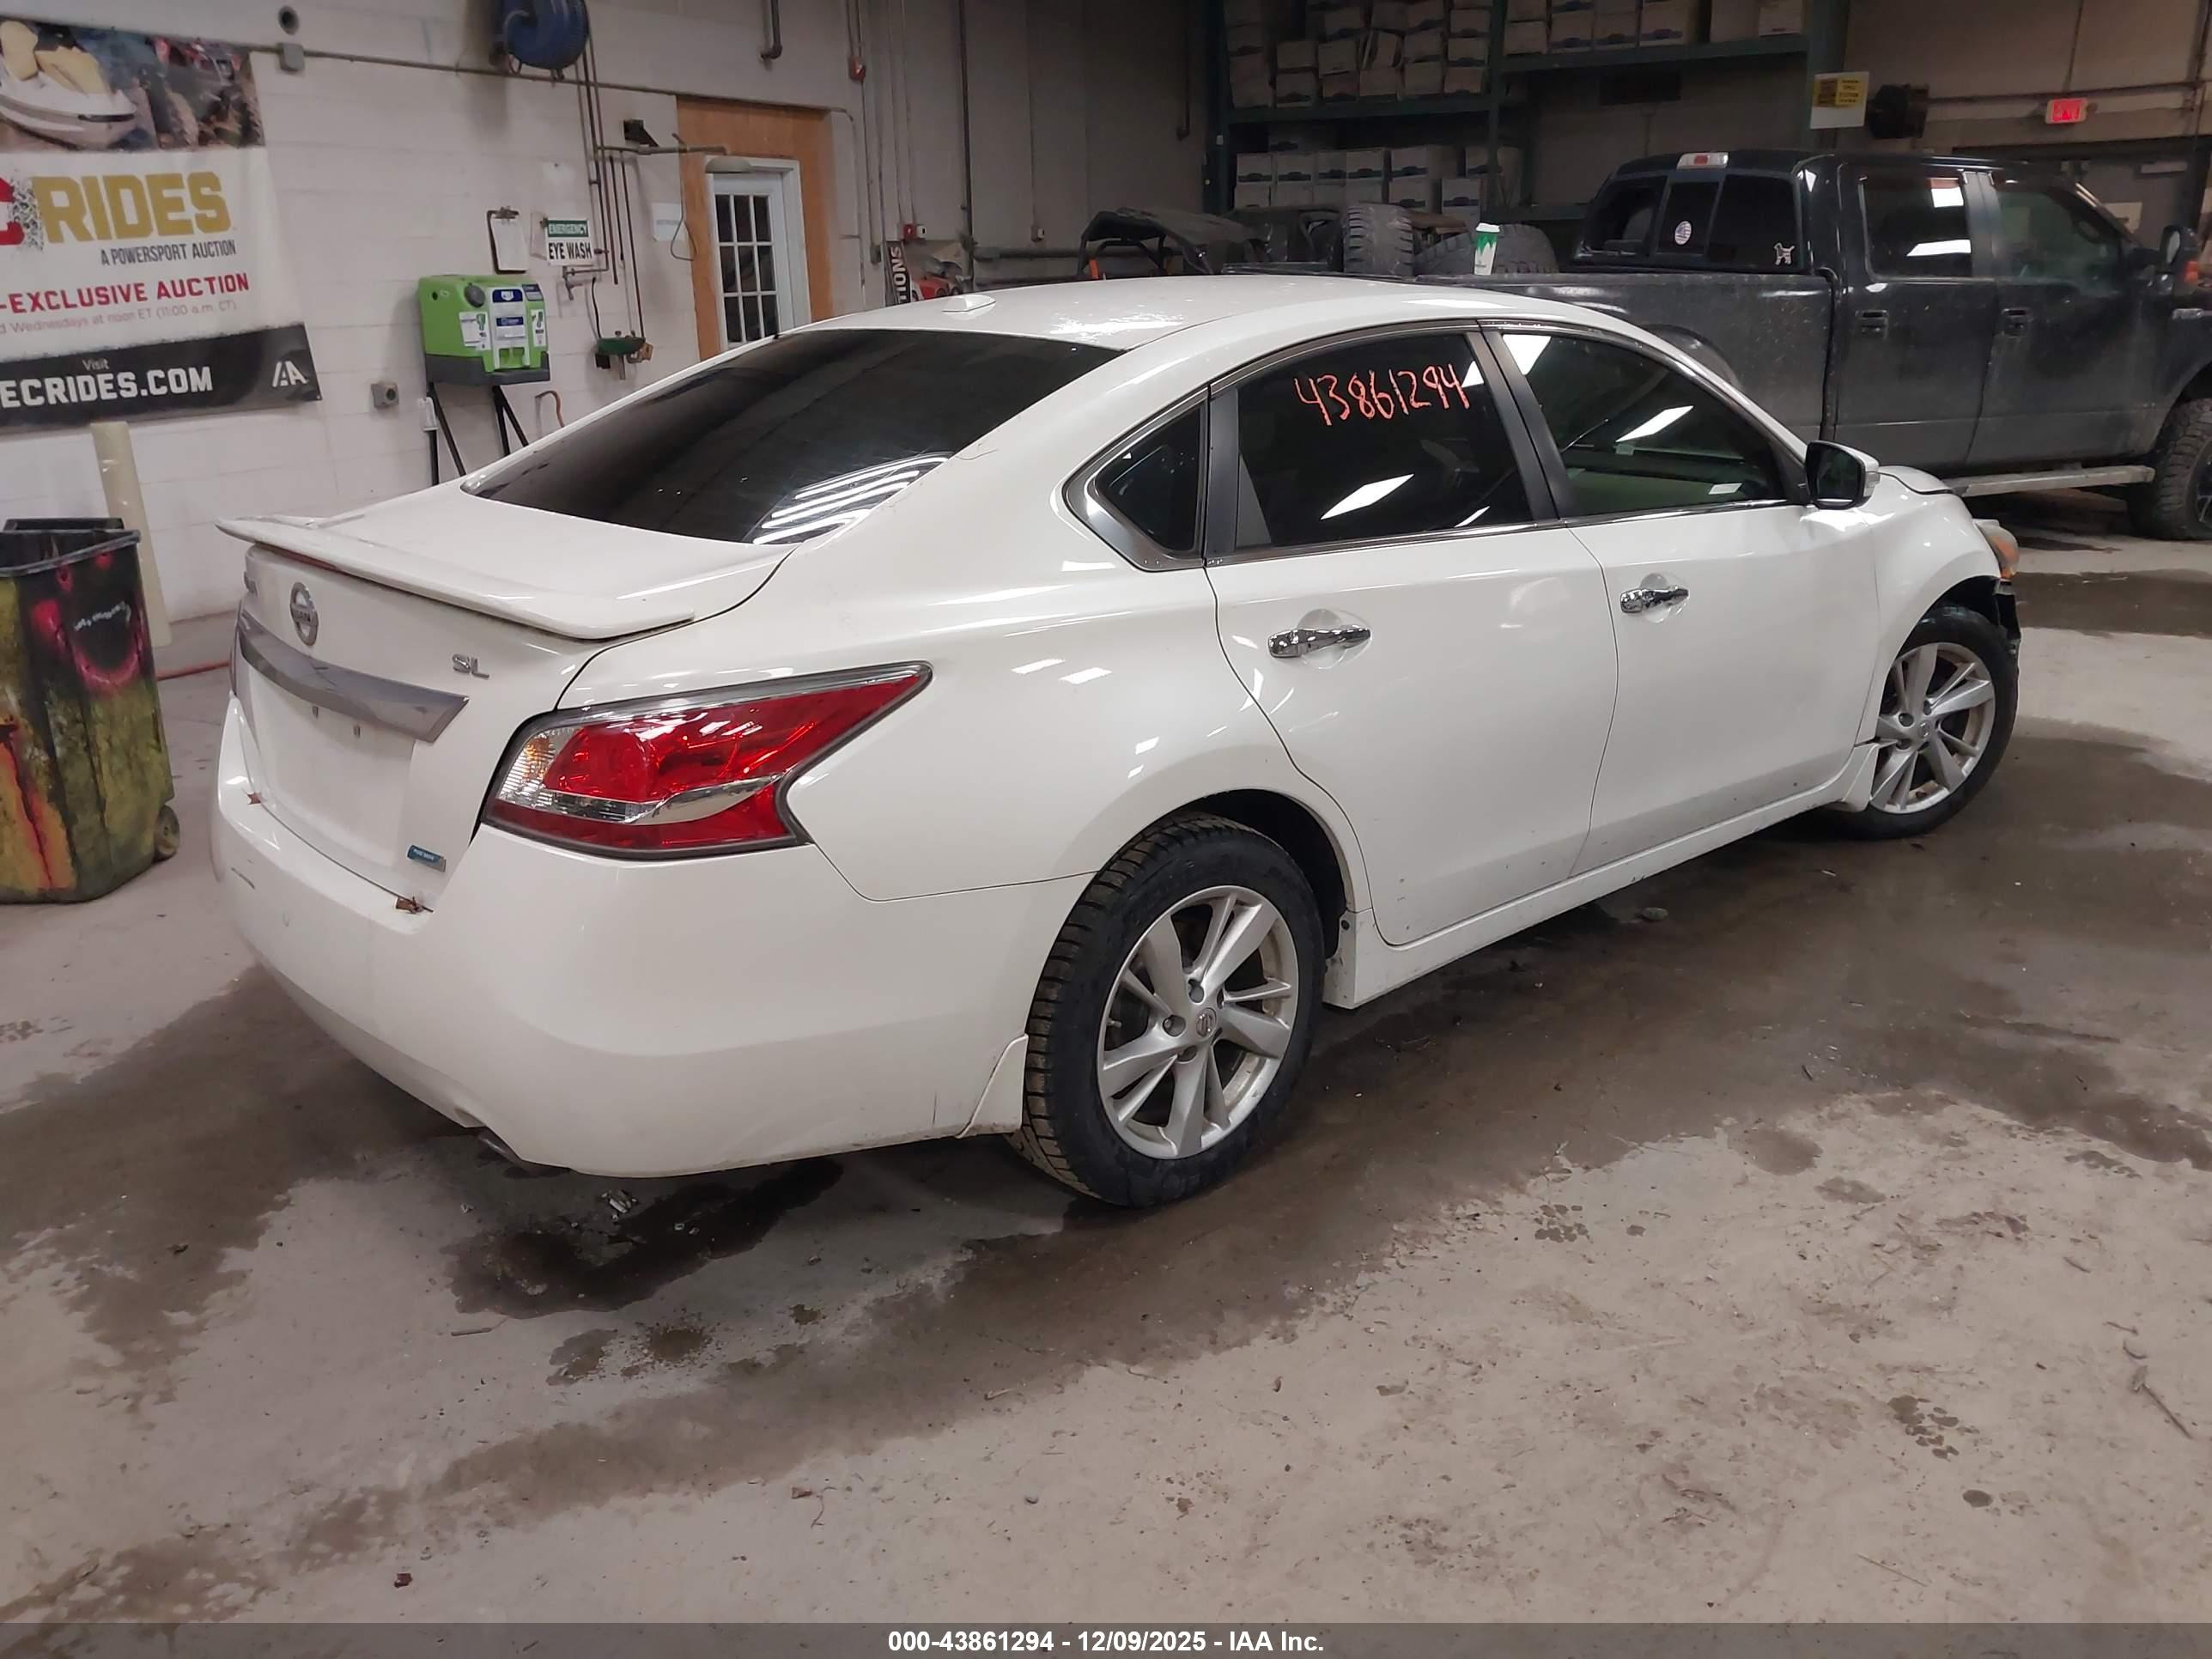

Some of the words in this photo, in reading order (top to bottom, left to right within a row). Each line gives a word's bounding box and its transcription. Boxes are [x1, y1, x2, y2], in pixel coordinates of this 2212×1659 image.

[31, 172, 232, 243] RIDES
[100, 249, 110, 266] A
[112, 244, 187, 264] POWERSPORT
[192, 240, 237, 260] AUCTION
[549, 242, 565, 259] EYE
[566, 242, 592, 259] WASH
[157, 272, 249, 301] AUCTION
[137, 308, 151, 319] ET
[82, 358, 110, 371] Visit
[1294, 363, 1470, 426] 43861294
[453, 653, 489, 679] SL
